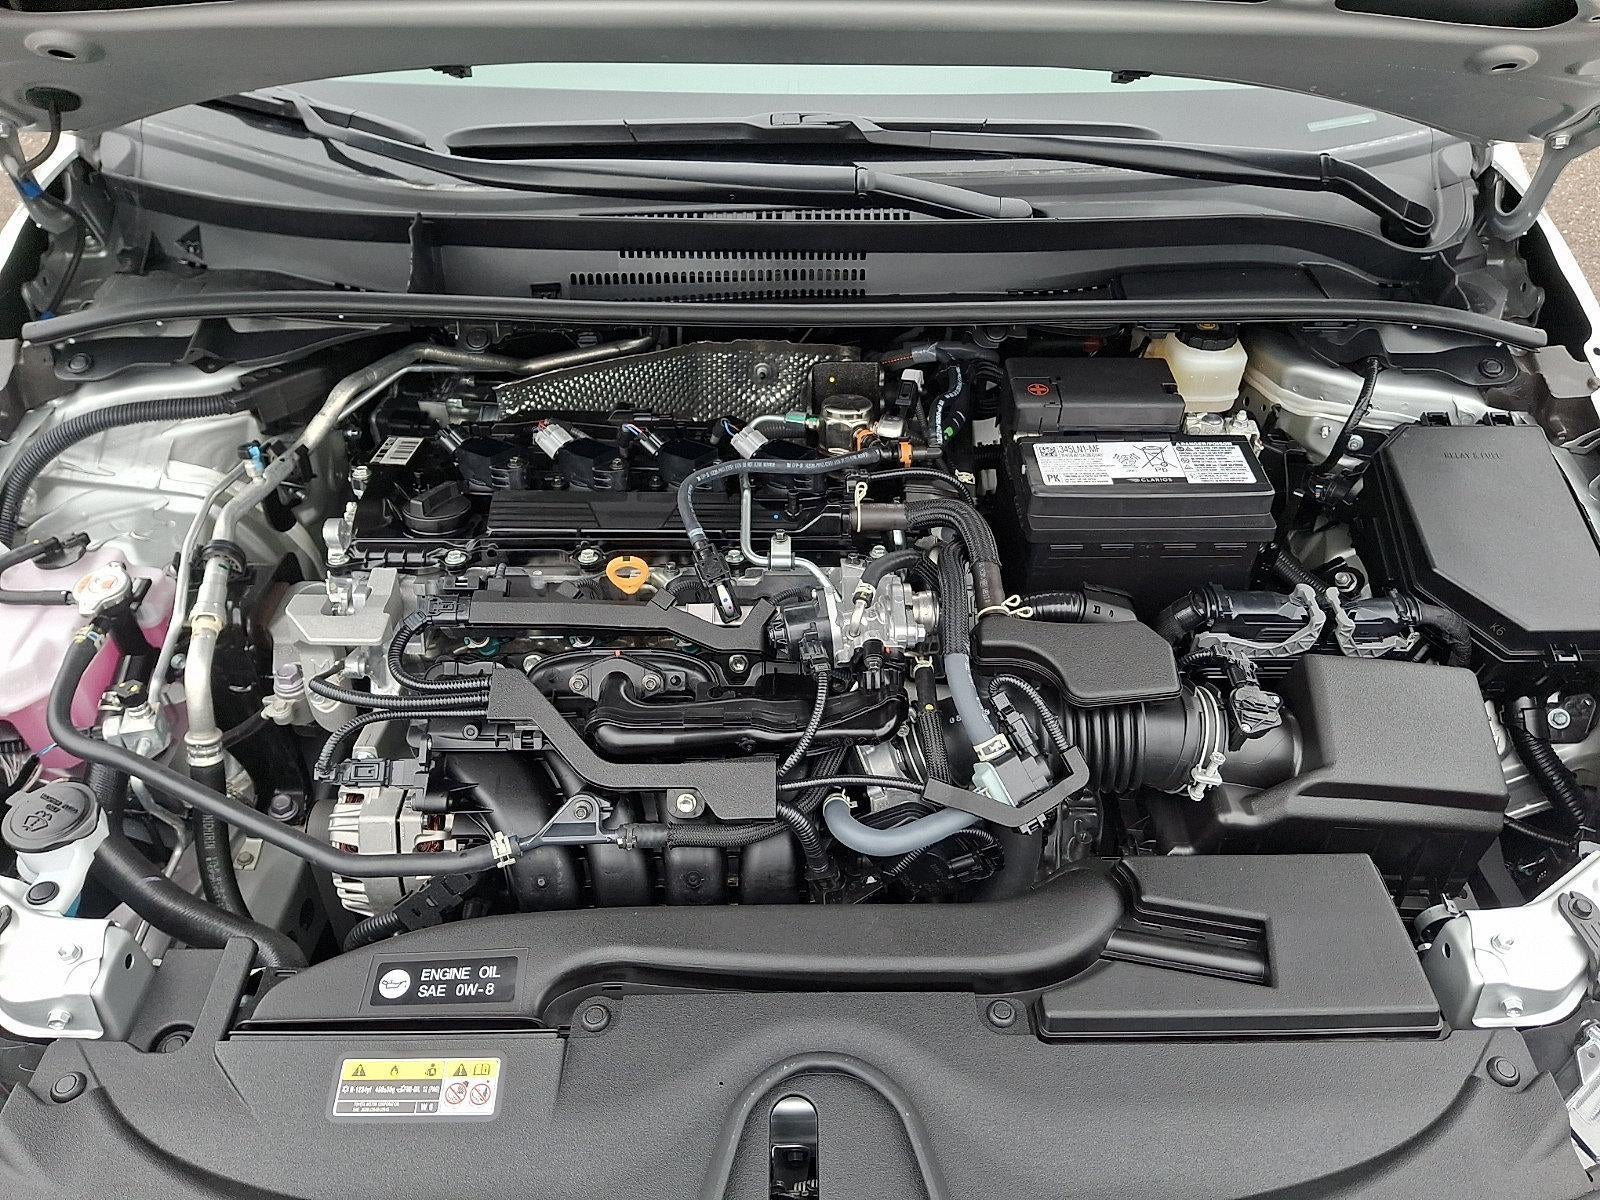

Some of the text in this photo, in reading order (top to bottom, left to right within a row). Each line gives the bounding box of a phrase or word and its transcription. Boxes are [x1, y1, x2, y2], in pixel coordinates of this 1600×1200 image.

[1047, 474, 1061, 483] PK
[1490, 623, 1506, 636] K6
[420, 965, 501, 981] ENGINE OIL
[417, 982, 495, 998] SAE 0W-8
